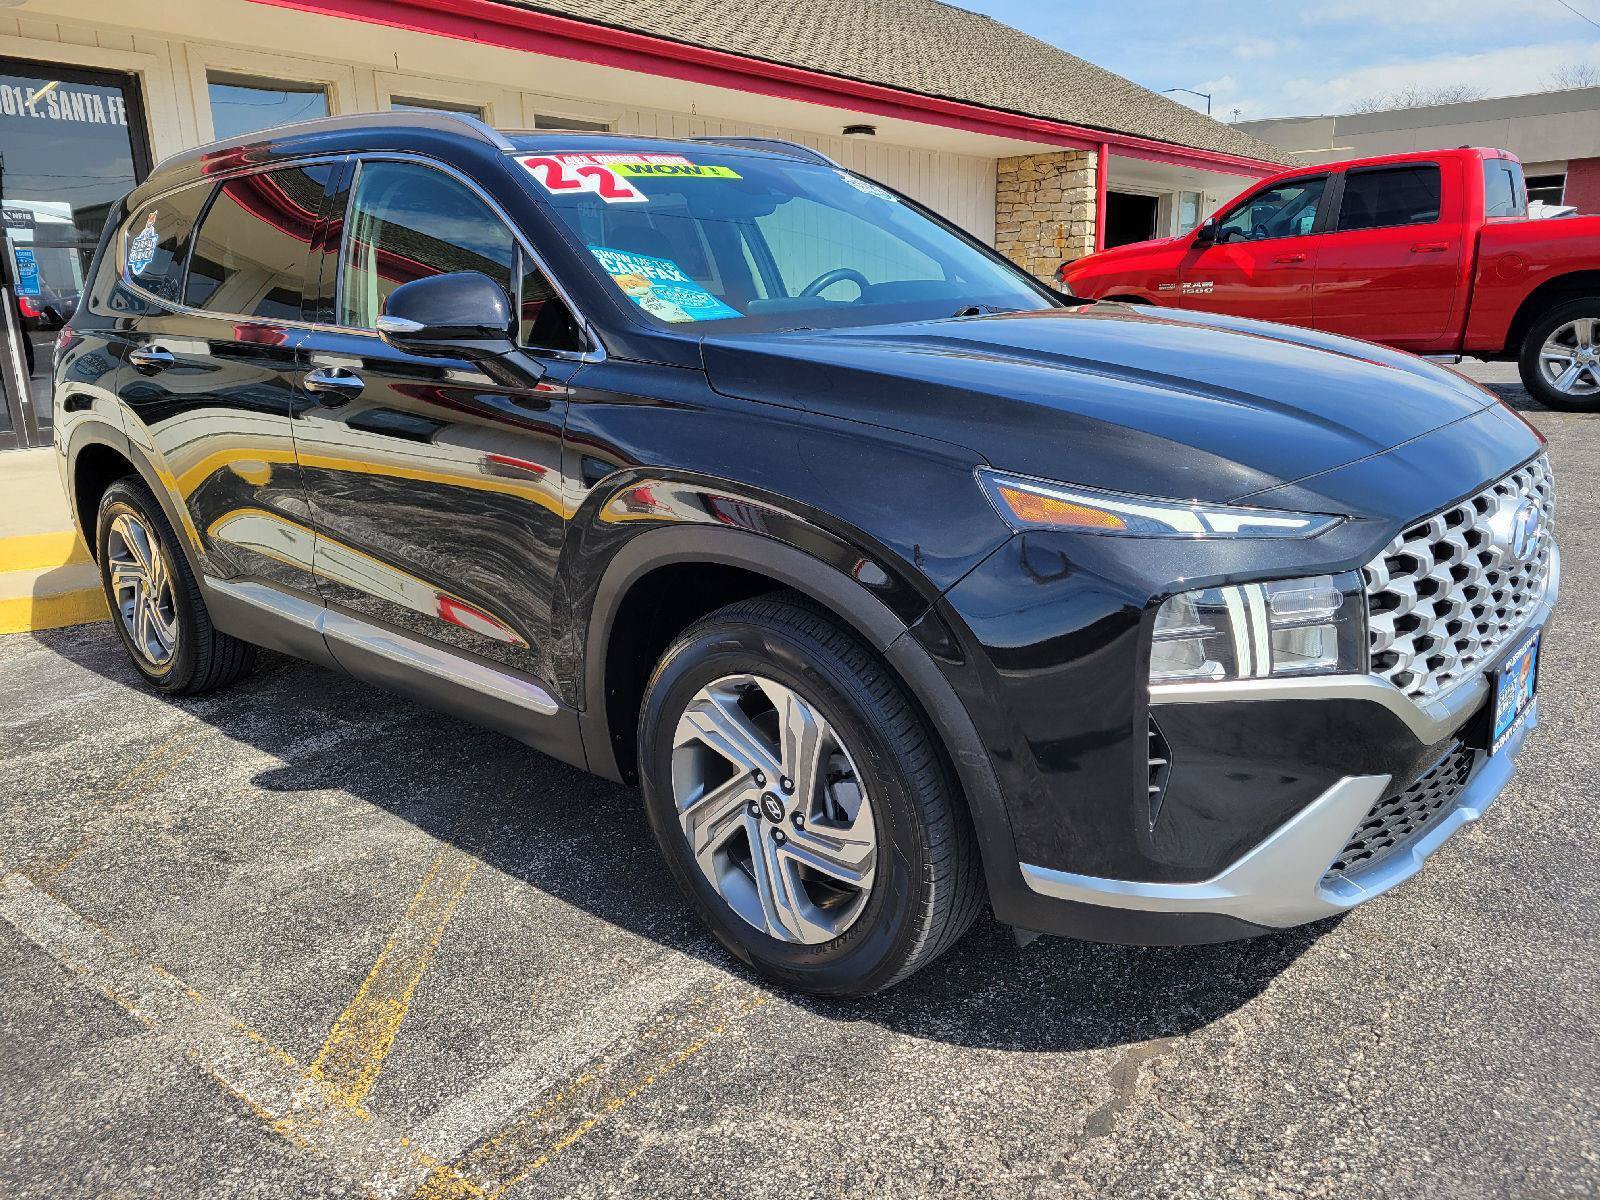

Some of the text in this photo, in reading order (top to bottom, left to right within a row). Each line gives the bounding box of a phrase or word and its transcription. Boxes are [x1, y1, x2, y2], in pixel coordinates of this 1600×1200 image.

[46, 89, 107, 125] SANTA
[107, 95, 128, 126] FE
[590, 249, 677, 271] SHOW ME THE
[599, 257, 691, 283] CARFAX
